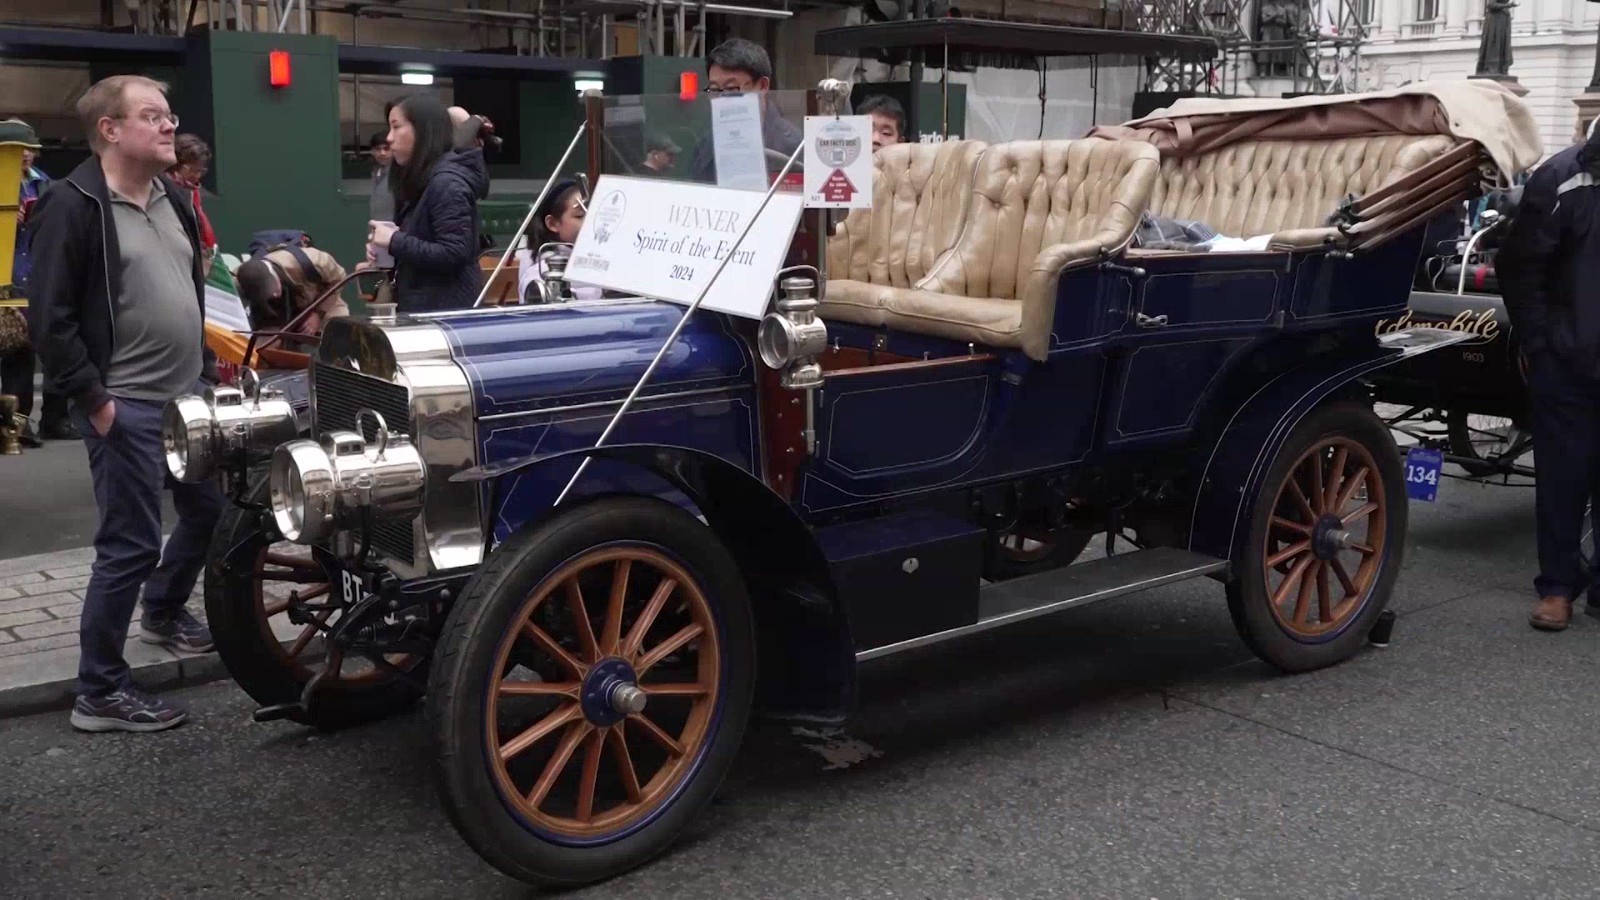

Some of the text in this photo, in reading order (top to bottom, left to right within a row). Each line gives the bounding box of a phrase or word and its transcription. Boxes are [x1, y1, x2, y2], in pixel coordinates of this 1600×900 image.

[669, 204, 740, 234] WINNER
[633, 229, 669, 254] Spirit
[670, 235, 689, 254] of
[689, 237, 711, 258] the
[669, 264, 695, 281] 2024
[1462, 351, 1485, 363] 1903
[1406, 465, 1437, 486] 134
[341, 569, 363, 603] BT
